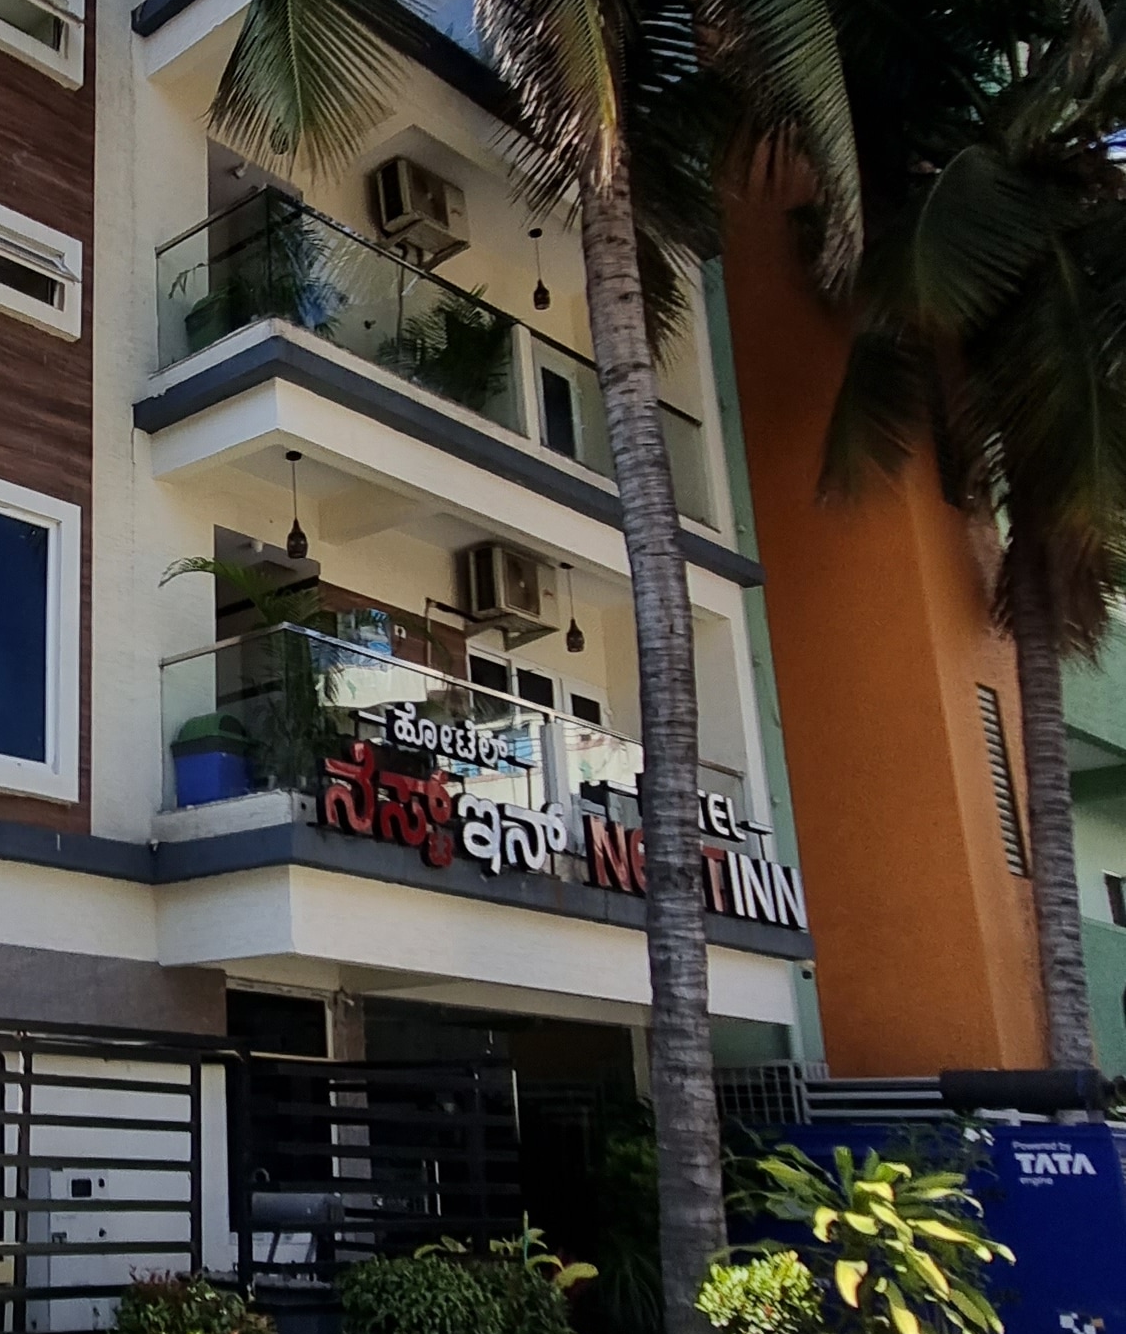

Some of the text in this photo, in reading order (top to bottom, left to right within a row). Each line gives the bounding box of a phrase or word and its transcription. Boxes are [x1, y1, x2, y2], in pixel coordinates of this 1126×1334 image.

[394, 702, 510, 766] ಹೋಟೆಲ್
[726, 850, 808, 934] INN
[1014, 1152, 1097, 1175] TATA
